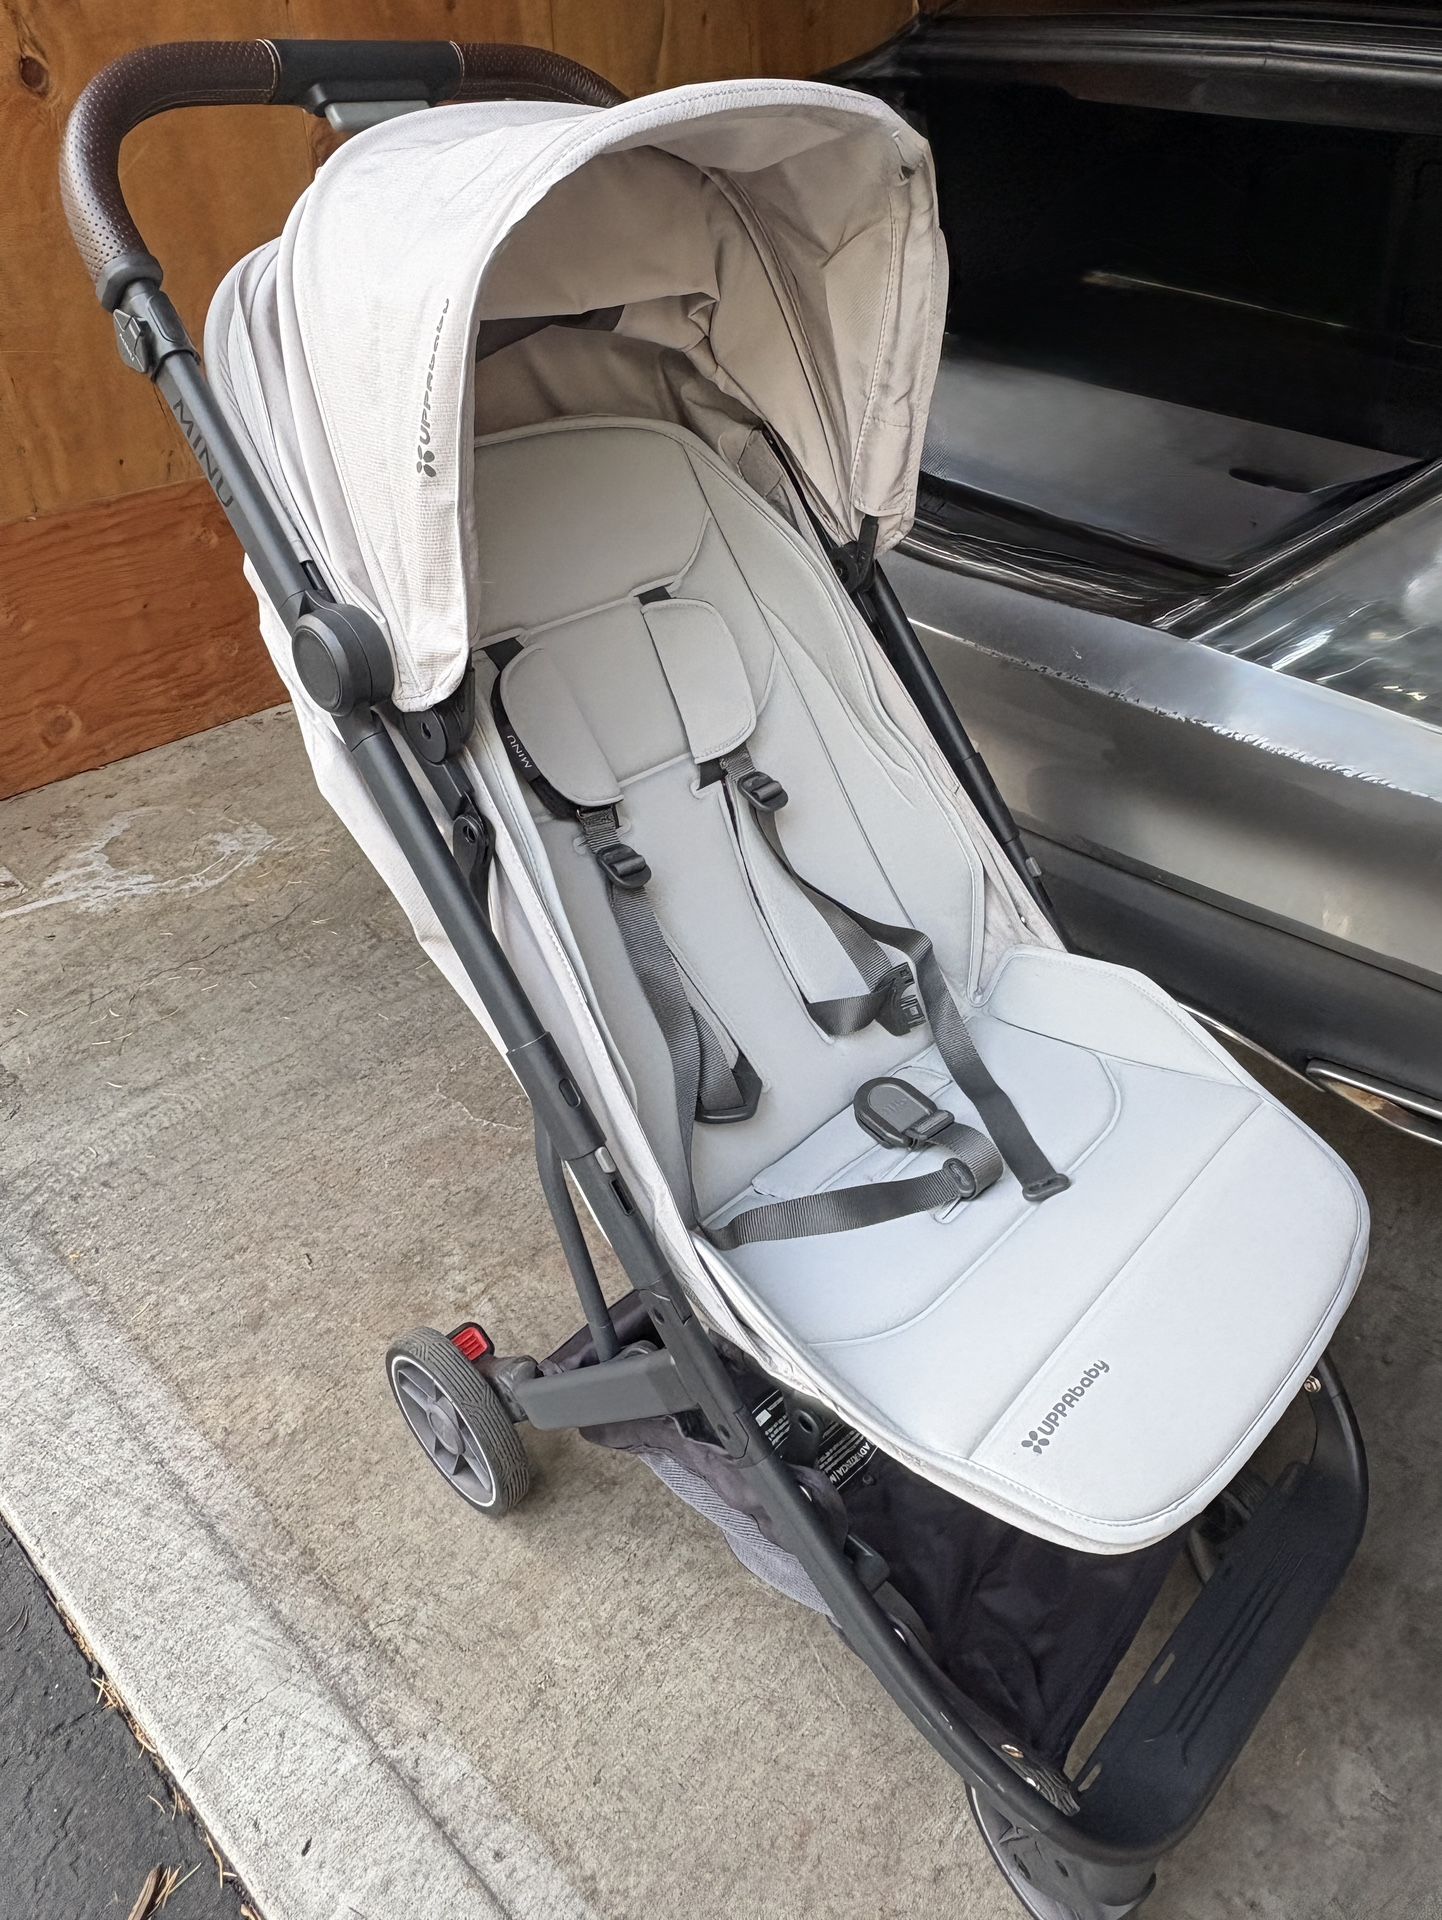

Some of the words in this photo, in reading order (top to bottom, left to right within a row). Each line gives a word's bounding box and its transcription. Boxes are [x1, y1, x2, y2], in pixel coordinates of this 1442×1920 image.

[172, 397, 235, 508] MINU
[506, 734, 533, 769] MINU
[1037, 1359, 1110, 1436] UPPAbaby
